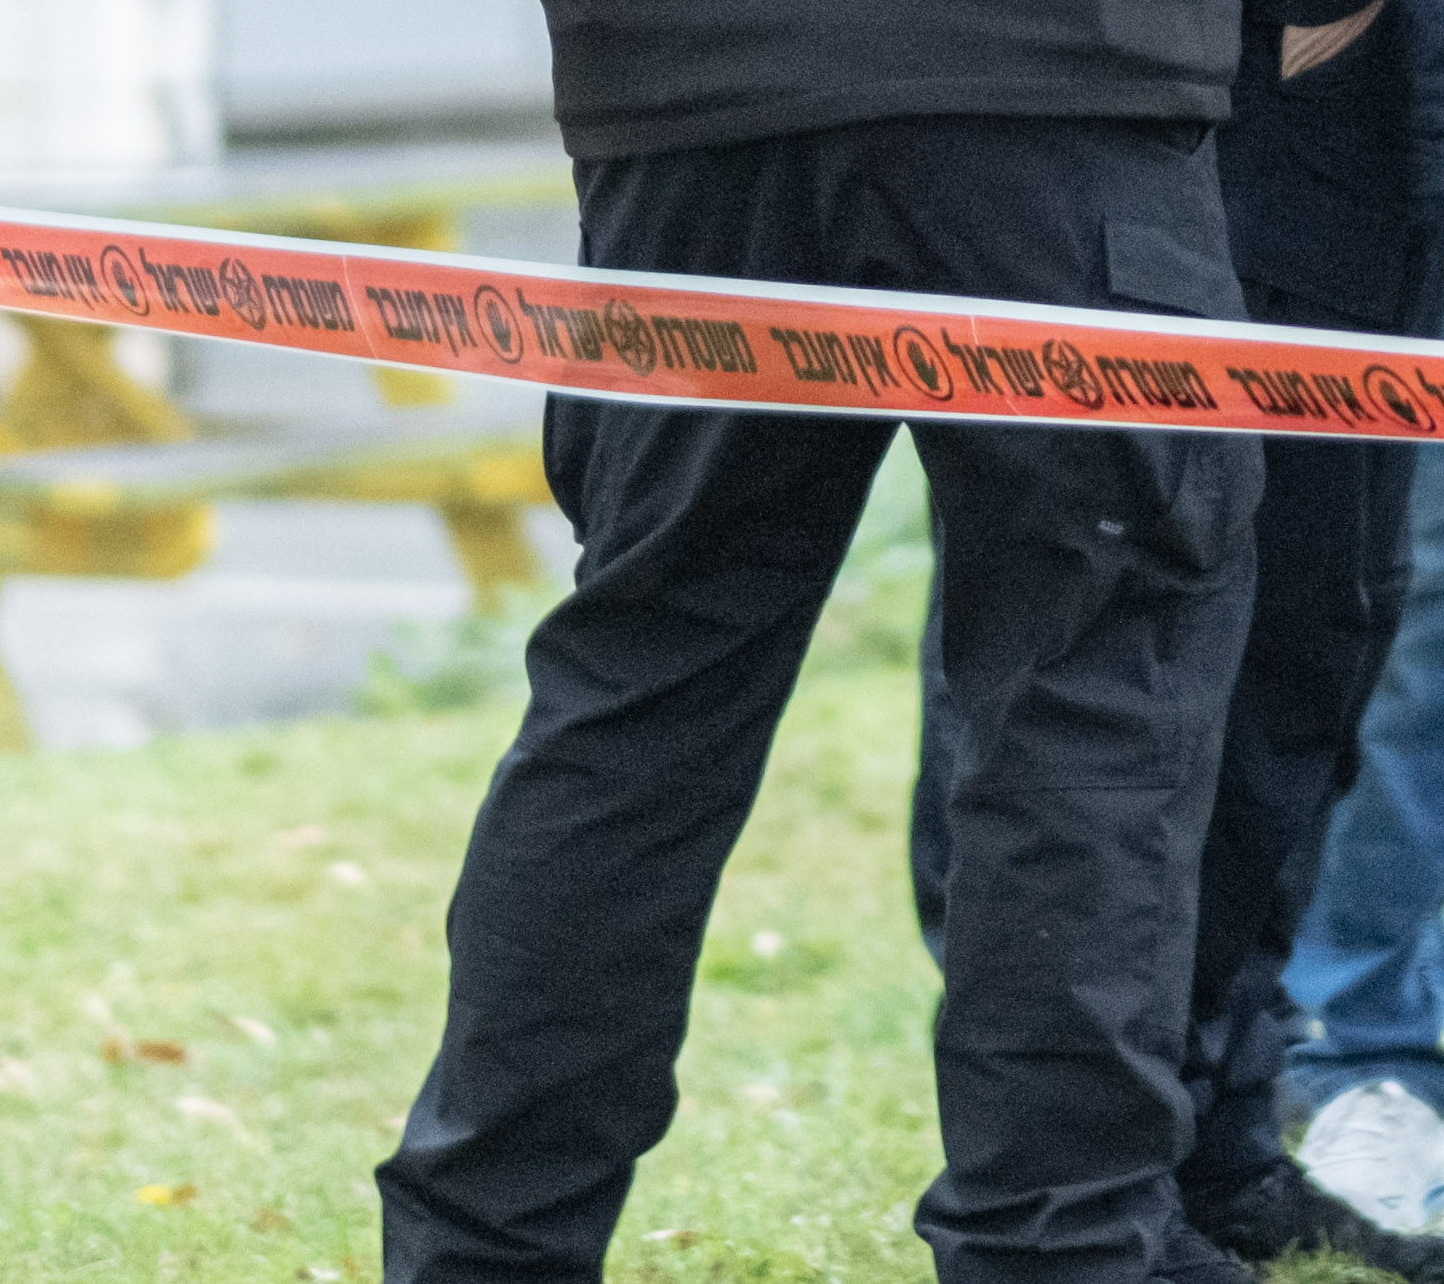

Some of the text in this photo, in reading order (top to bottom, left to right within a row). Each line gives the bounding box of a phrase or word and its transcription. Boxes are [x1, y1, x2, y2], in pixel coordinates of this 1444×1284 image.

[0, 246, 355, 332] משטרת ישראל אין מעבר
[366, 284, 757, 374] משטרת ישראל אין מעבר
[769, 326, 1219, 410] משטרת ישראל אין מעבר
[1226, 366, 1329, 420] מעבר
[1310, 373, 1378, 426] אין
